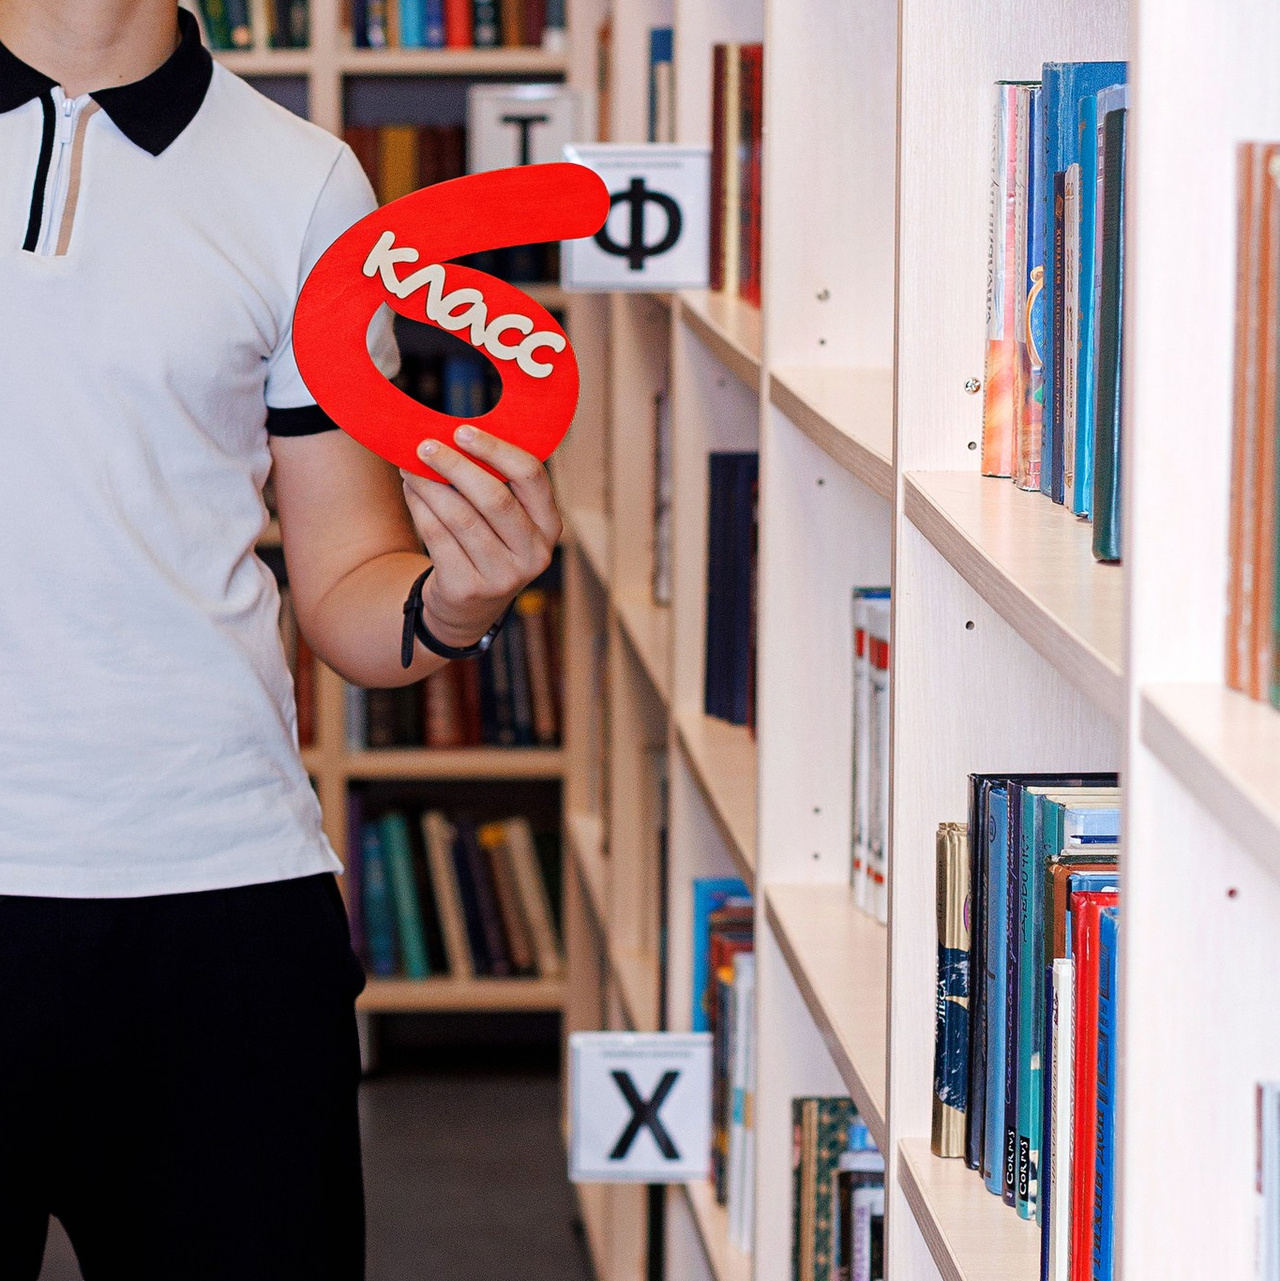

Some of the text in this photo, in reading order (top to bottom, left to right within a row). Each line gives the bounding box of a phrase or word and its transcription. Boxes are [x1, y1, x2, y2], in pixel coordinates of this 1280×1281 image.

[499, 114, 549, 164] Т
[592, 177, 684, 270] Ф
[610, 1068, 681, 1161] Х
